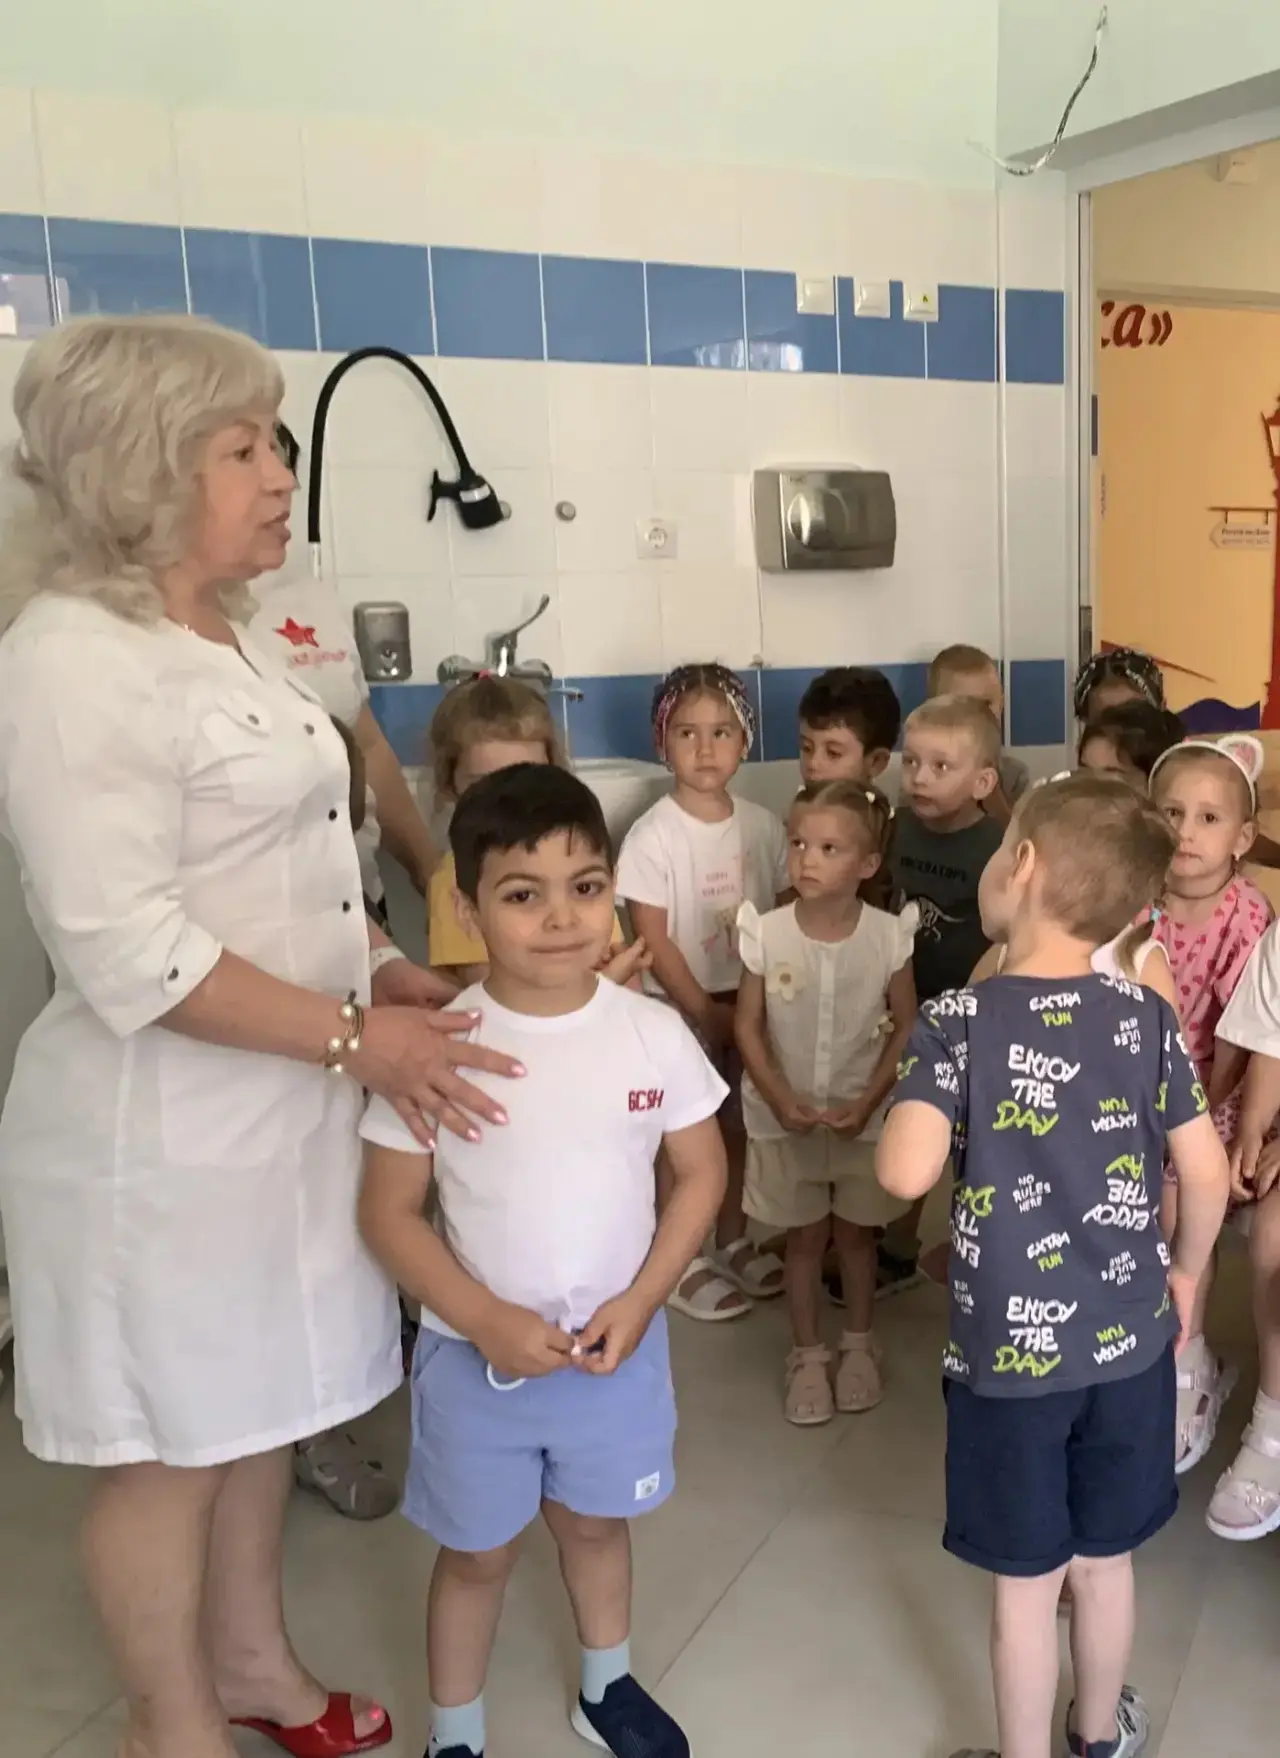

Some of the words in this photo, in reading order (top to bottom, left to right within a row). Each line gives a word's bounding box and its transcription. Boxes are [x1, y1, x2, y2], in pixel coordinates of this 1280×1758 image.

[1029, 991, 1081, 1012] EXTRA
[1042, 1011, 1072, 1028] FUN
[1008, 1042, 1081, 1083] ENJOY
[1011, 1078, 1056, 1109] THE
[1099, 1096, 1129, 1113] FUN
[992, 1099, 1059, 1136] DAY
[1013, 1181, 1051, 1204] RULES
[1018, 1173, 1035, 1186] NO
[1107, 1178, 1148, 1205] THE
[1082, 1203, 1149, 1231] ENJOY
[1027, 1231, 1070, 1260] EXTRA
[1038, 1252, 1064, 1273] FUN
[1006, 1295, 1078, 1325] ENJOY
[1008, 1326, 1059, 1352] THE
[1096, 1323, 1126, 1344] FUN
[992, 1345, 1062, 1377] DAY
[1093, 1334, 1137, 1365] EXTRA
